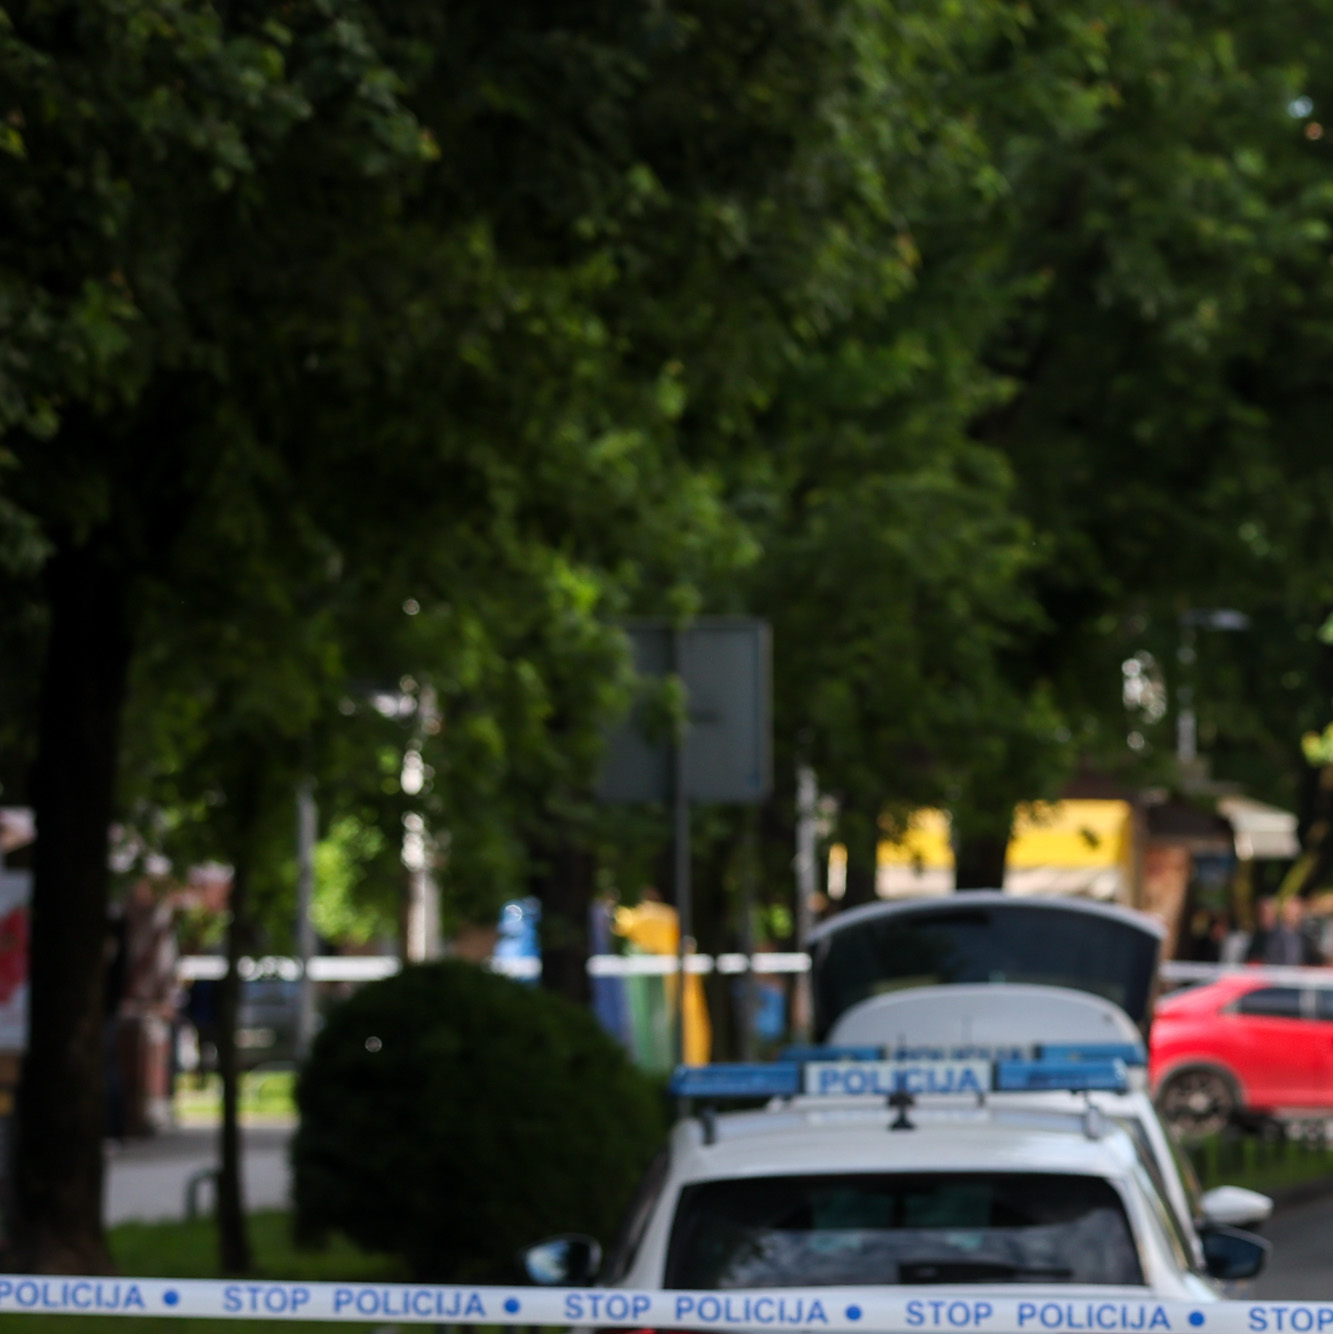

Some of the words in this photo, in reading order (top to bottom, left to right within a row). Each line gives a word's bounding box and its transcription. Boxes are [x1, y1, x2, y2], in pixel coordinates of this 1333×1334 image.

[224, 1285, 310, 1312] STOP
[333, 1288, 487, 1318] POLICIJA
[564, 1293, 652, 1321] STOP
[674, 1296, 829, 1325] POLICIJA
[905, 1301, 994, 1328] STOP
[1017, 1303, 1172, 1331] POLICIJA
